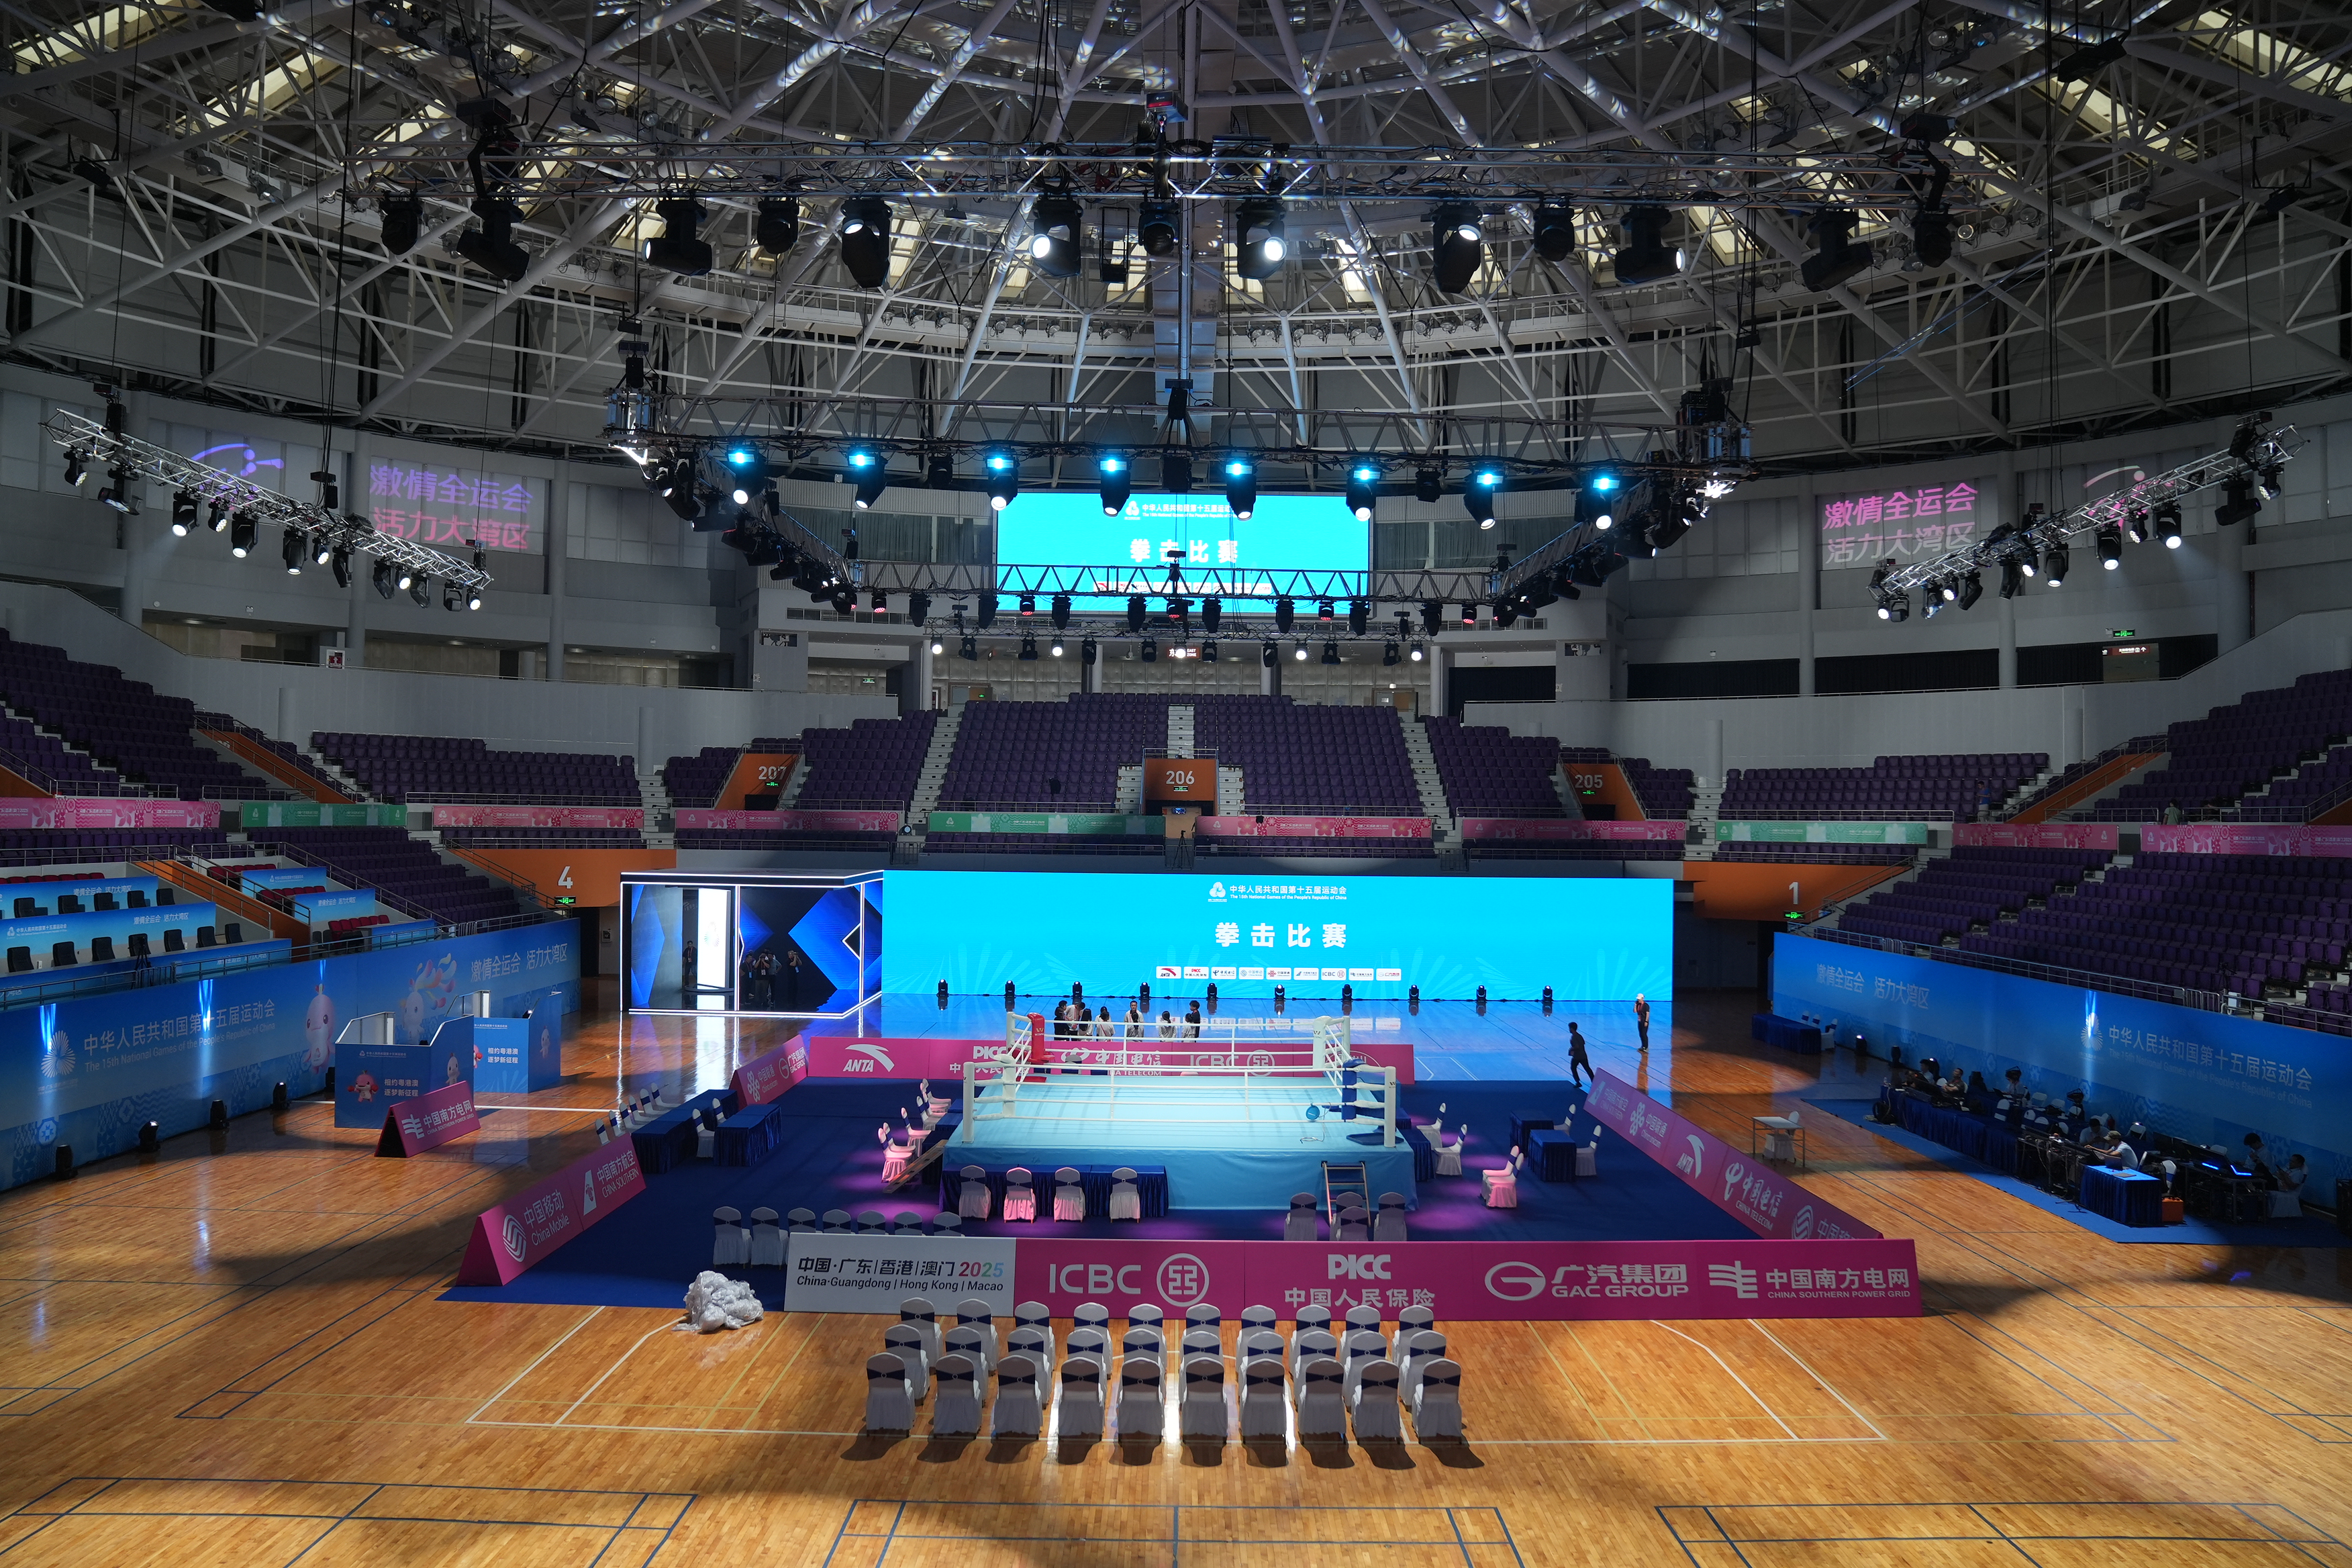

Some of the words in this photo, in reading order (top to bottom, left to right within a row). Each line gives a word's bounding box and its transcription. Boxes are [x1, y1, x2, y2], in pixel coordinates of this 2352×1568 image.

[369, 464, 533, 513] 激情全运会
[1142, 504, 1232, 513] 中华人民共和国第十五届运动
[1822, 482, 1978, 530] 激情全运会
[373, 507, 530, 549] 活力大湾区
[1825, 522, 1975, 564] 活力大湾区
[758, 766, 787, 780] 207
[1166, 771, 1195, 785] 206
[1575, 775, 1603, 789] 205
[558, 866, 573, 889] 4
[1230, 885, 1346, 894] 中华人民共和国第十五届运动会
[1789, 881, 1800, 905] 1
[1214, 922, 1346, 948] 拳击比赛
[471, 952, 521, 982] 激情全运会
[526, 943, 568, 970] 活力大湾区
[1816, 963, 1865, 993] 激情全运会
[1874, 976, 1930, 1009] 活力大湾区
[84, 999, 275, 1056] 中华人民共和国第十五届运动会
[85, 1062, 100, 1072] The
[103, 1057, 119, 1069] 15th
[121, 1048, 152, 1065] National
[153, 1044, 176, 1057] Games
[179, 1042, 187, 1051] of
[187, 1040, 197, 1049] the
[199, 1033, 224, 1047] People's
[226, 1027, 252, 1041] Republic
[252, 1026, 258, 1034] of
[260, 1022, 275, 1033] China
[2109, 1025, 2312, 1091] 中华人民共和国第十五届运动会
[842, 1059, 874, 1072] ANTA
[384, 1079, 419, 1087] 相约粤港澳
[2110, 1048, 2120, 1059] The
[2122, 1051, 2135, 1062] 15th
[2137, 1055, 2162, 1069] National
[2164, 1063, 2187, 1077] Games
[2188, 1069, 2196, 1077] of
[2197, 1069, 2208, 1081] the
[2210, 1073, 2240, 1091] People's
[2242, 1081, 2275, 1099] Republic
[2277, 1091, 2286, 1101] of
[2288, 1093, 2312, 1109] China
[384, 1089, 419, 1097] 逐梦新征程
[423, 1099, 473, 1128] 中国南方电网
[427, 1126, 438, 1135] CHINA
[437, 1120, 456, 1132] SOUTHERN
[454, 1116, 467, 1125] POWER
[597, 1149, 636, 1185] 中国南方航空
[1676, 1153, 1694, 1175] ANTA
[601, 1184, 616, 1199] CHINA
[615, 1167, 640, 1191] SOUTHERN
[1743, 1171, 1783, 1218] 中国电信
[524, 1189, 565, 1230] 中国移动
[1735, 1199, 1751, 1217] CHINA
[1751, 1208, 1774, 1232] TELECOM
[531, 1226, 550, 1246] China
[549, 1213, 570, 1236] Mobile
[1817, 1218, 1857, 1239] 中国移
[959, 1261, 1004, 1277] 2025
[1049, 1263, 1141, 1294] ICBC
[1327, 1254, 1391, 1279] PICC
[1551, 1264, 1687, 1284] 广汽集团
[1766, 1267, 1910, 1289] 中国南方电网
[900, 1279, 928, 1291] Hong
[931, 1279, 959, 1292] Kong
[967, 1281, 1003, 1291] Macao
[1284, 1287, 1435, 1308] 中国人民保险
[1551, 1285, 1602, 1297] GAC
[1604, 1285, 1689, 1297] GROUP
[1767, 1291, 1797, 1299] CHINA
